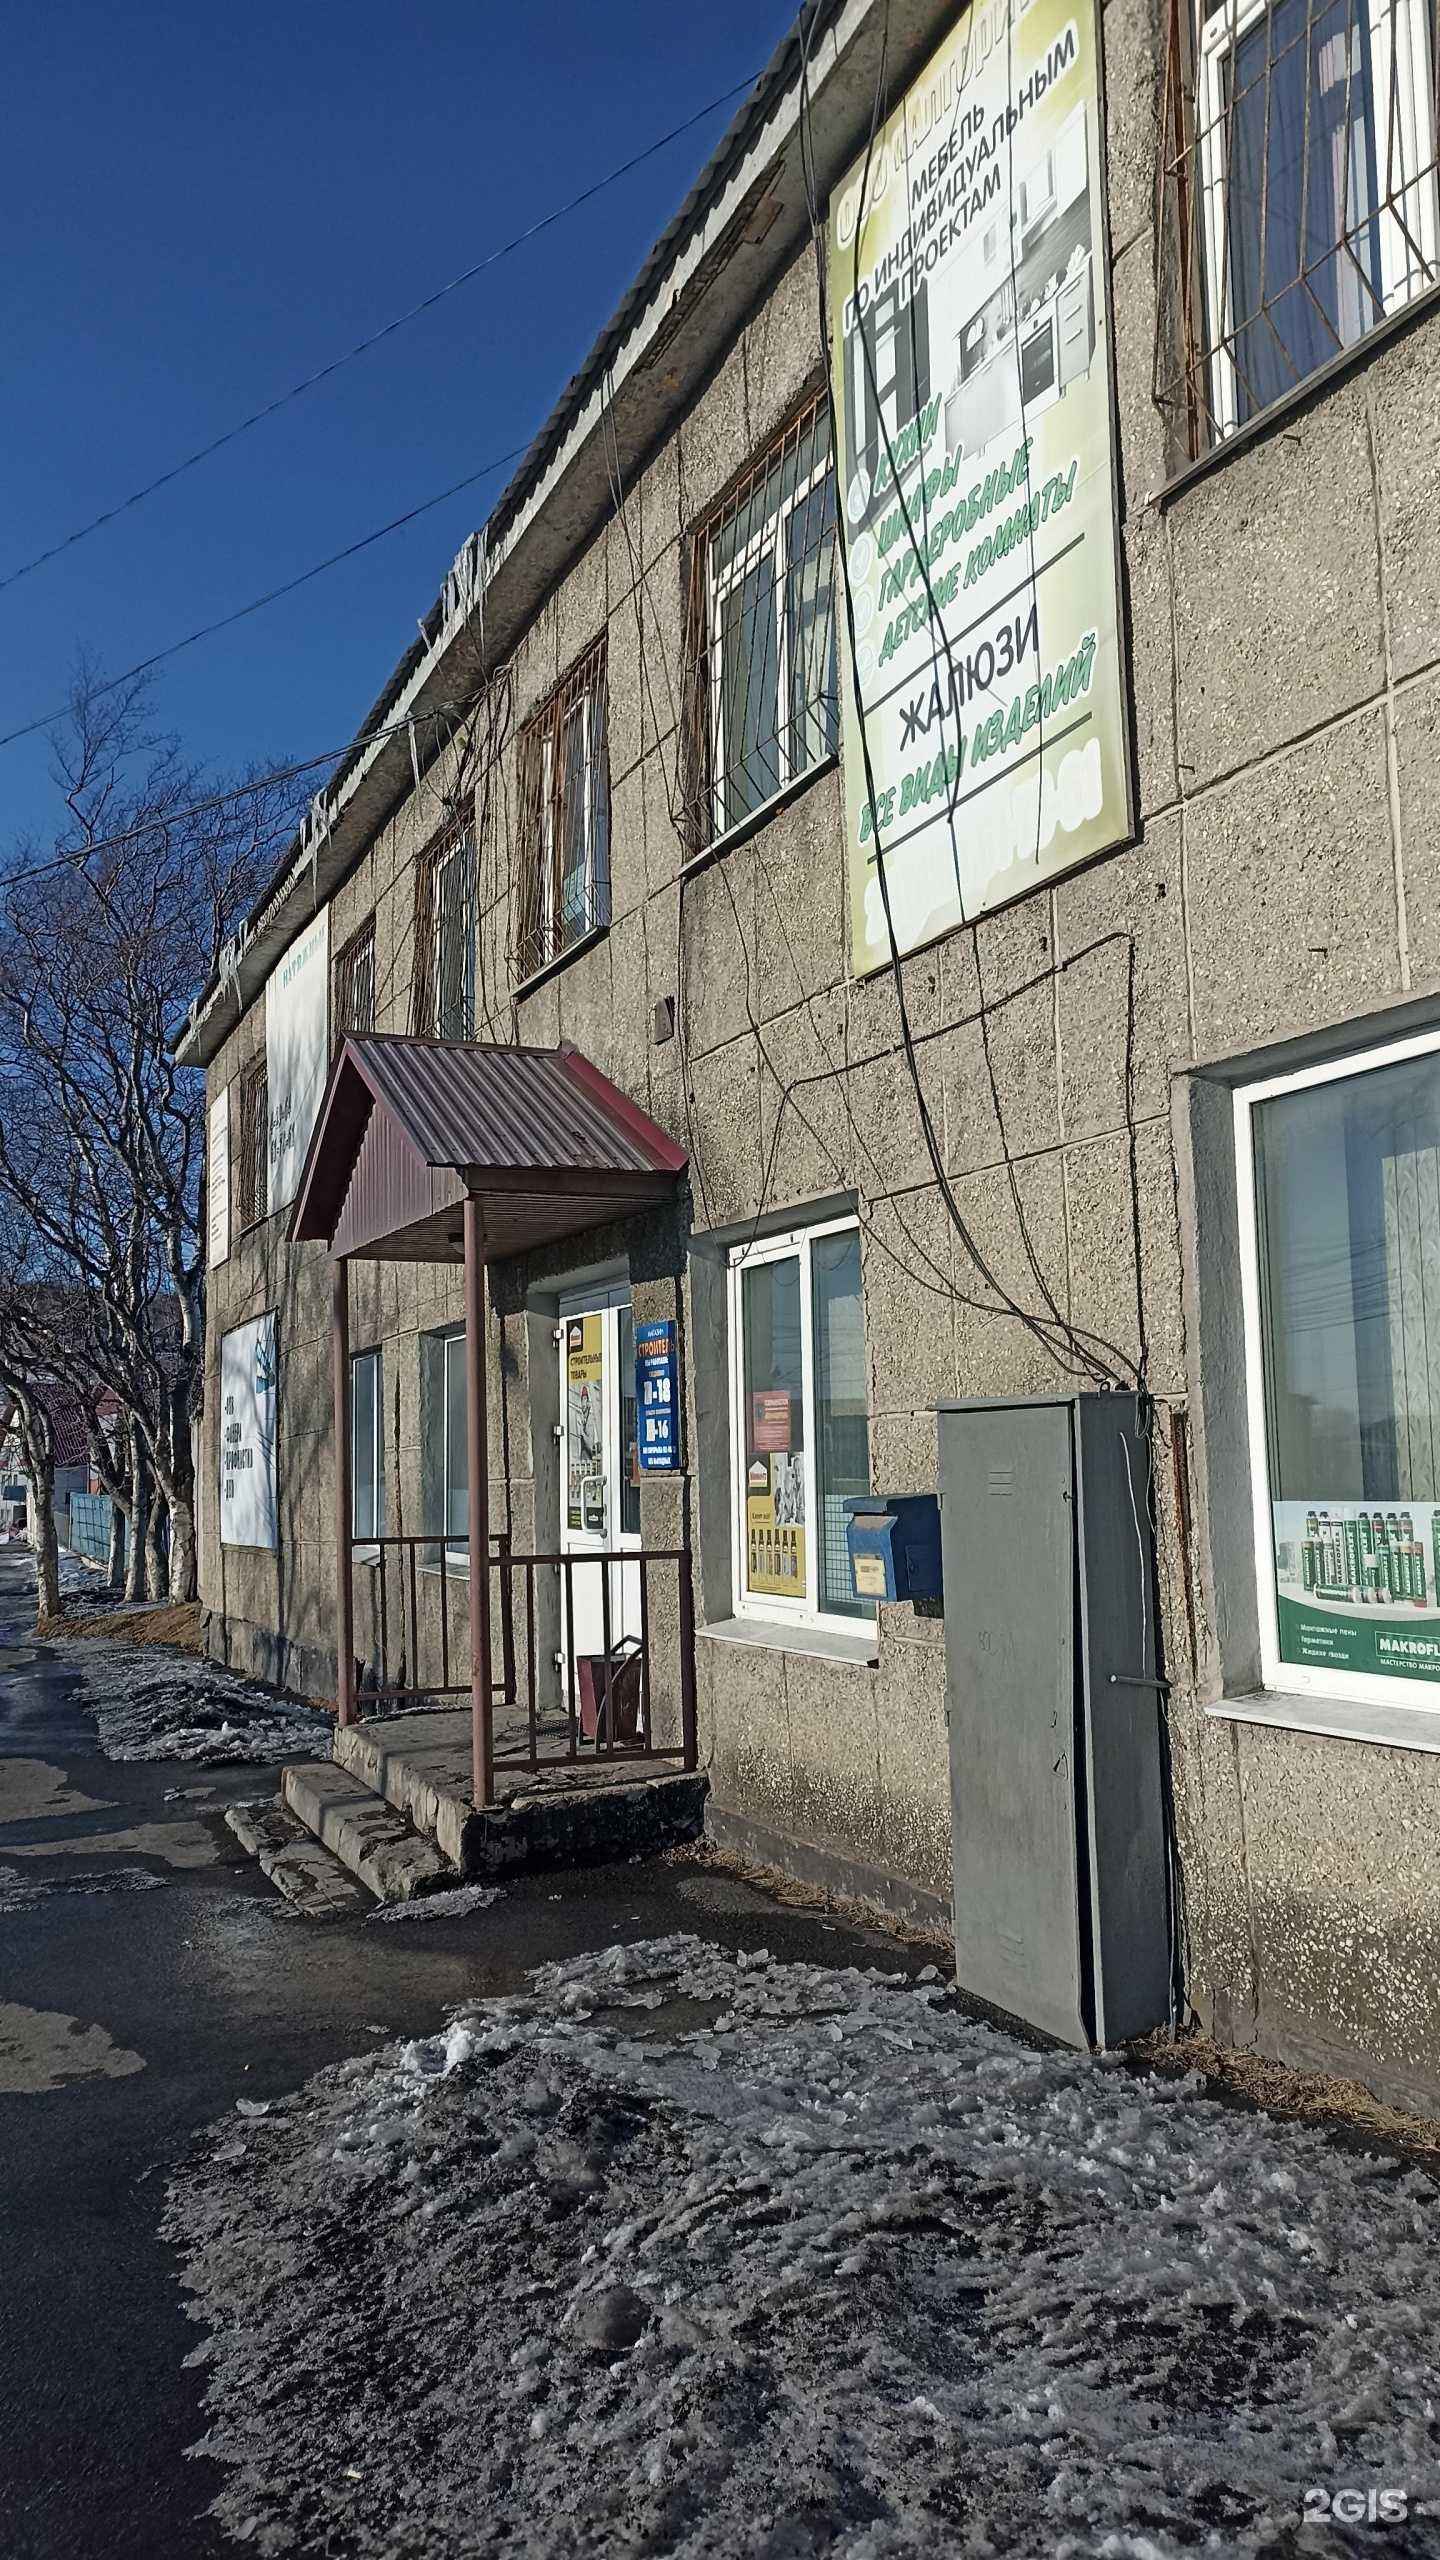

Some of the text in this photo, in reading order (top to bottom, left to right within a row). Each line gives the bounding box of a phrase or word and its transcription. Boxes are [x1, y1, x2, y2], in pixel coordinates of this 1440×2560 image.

[845, 283, 869, 330] ПО
[875, 29, 1075, 294] ИНДИВИДУАЛЬНЫМ
[911, 104, 985, 210] МЕБЕЛЬ
[902, 163, 1001, 302] ПРОЕКТАМ
[875, 392, 942, 493] КУХНИ
[878, 444, 963, 559] ШКАФЫ
[878, 437, 1033, 612] ГАРДЕРОБНЫЕ
[963, 461, 1077, 589] КОМНАТЫ
[860, 633, 1096, 843] ВСЕ ВИДЫ ИЗДЕЛИЙ
[899, 603, 1039, 751] ЖАЛЮЗИ
